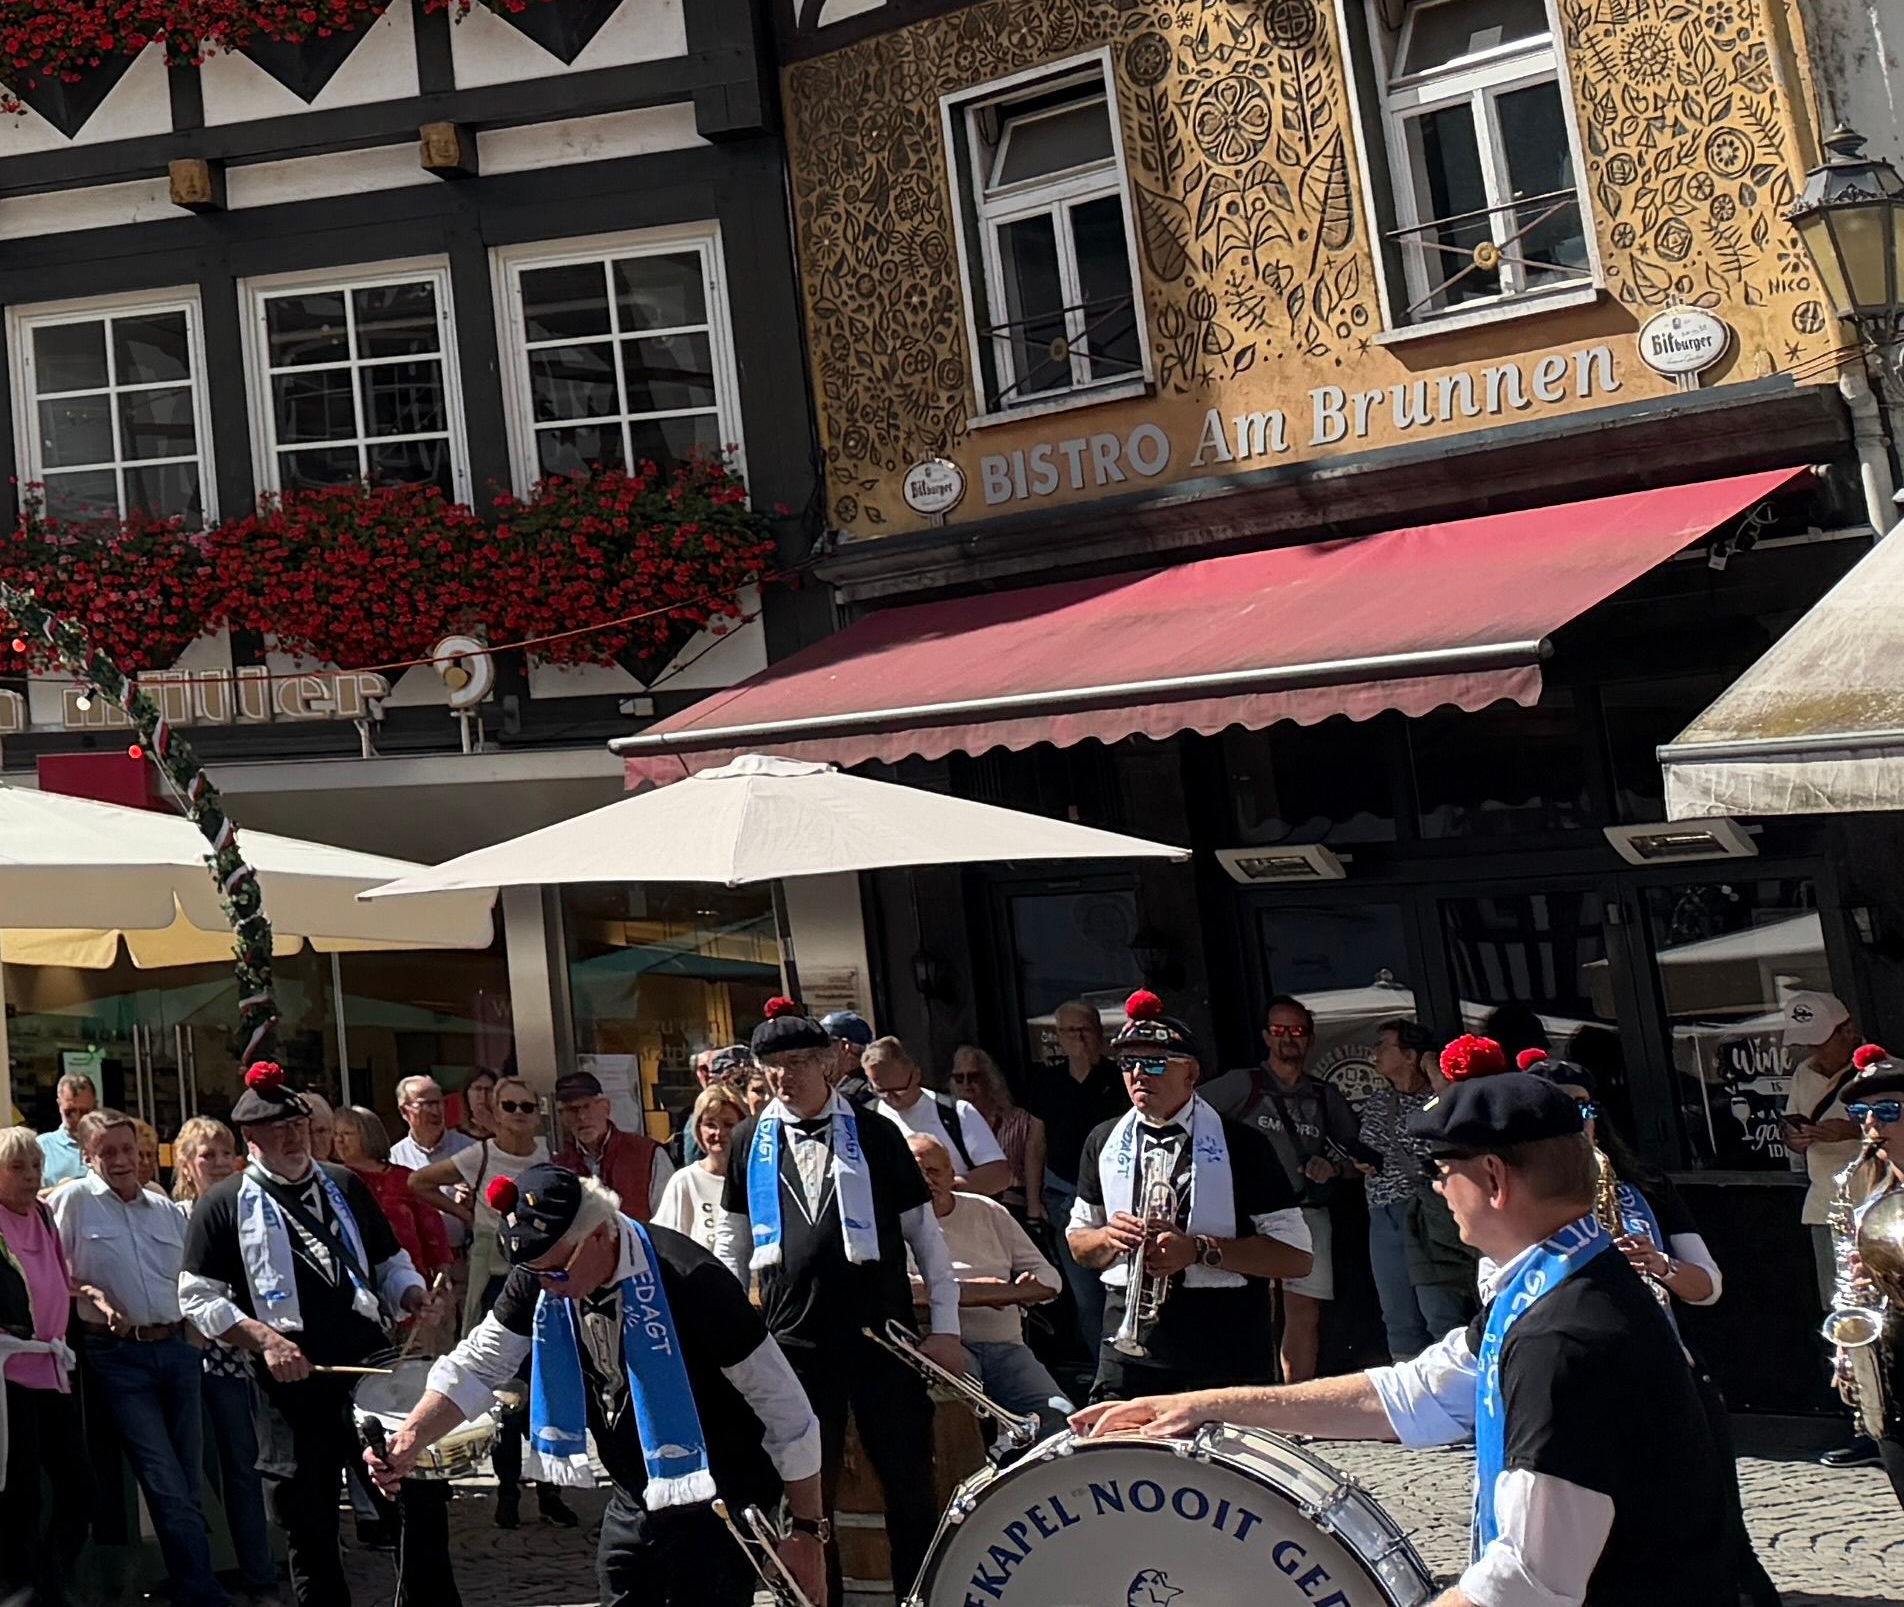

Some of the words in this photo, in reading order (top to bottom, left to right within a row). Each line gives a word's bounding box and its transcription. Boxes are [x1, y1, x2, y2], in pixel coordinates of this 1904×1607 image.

[1768, 276, 1810, 295] NICO
[980, 422, 1171, 505] BISTRO
[1190, 408, 1290, 467] Am
[1308, 345, 1623, 447] Brunnen
[1088, 1479, 1262, 1543] NOOIT
